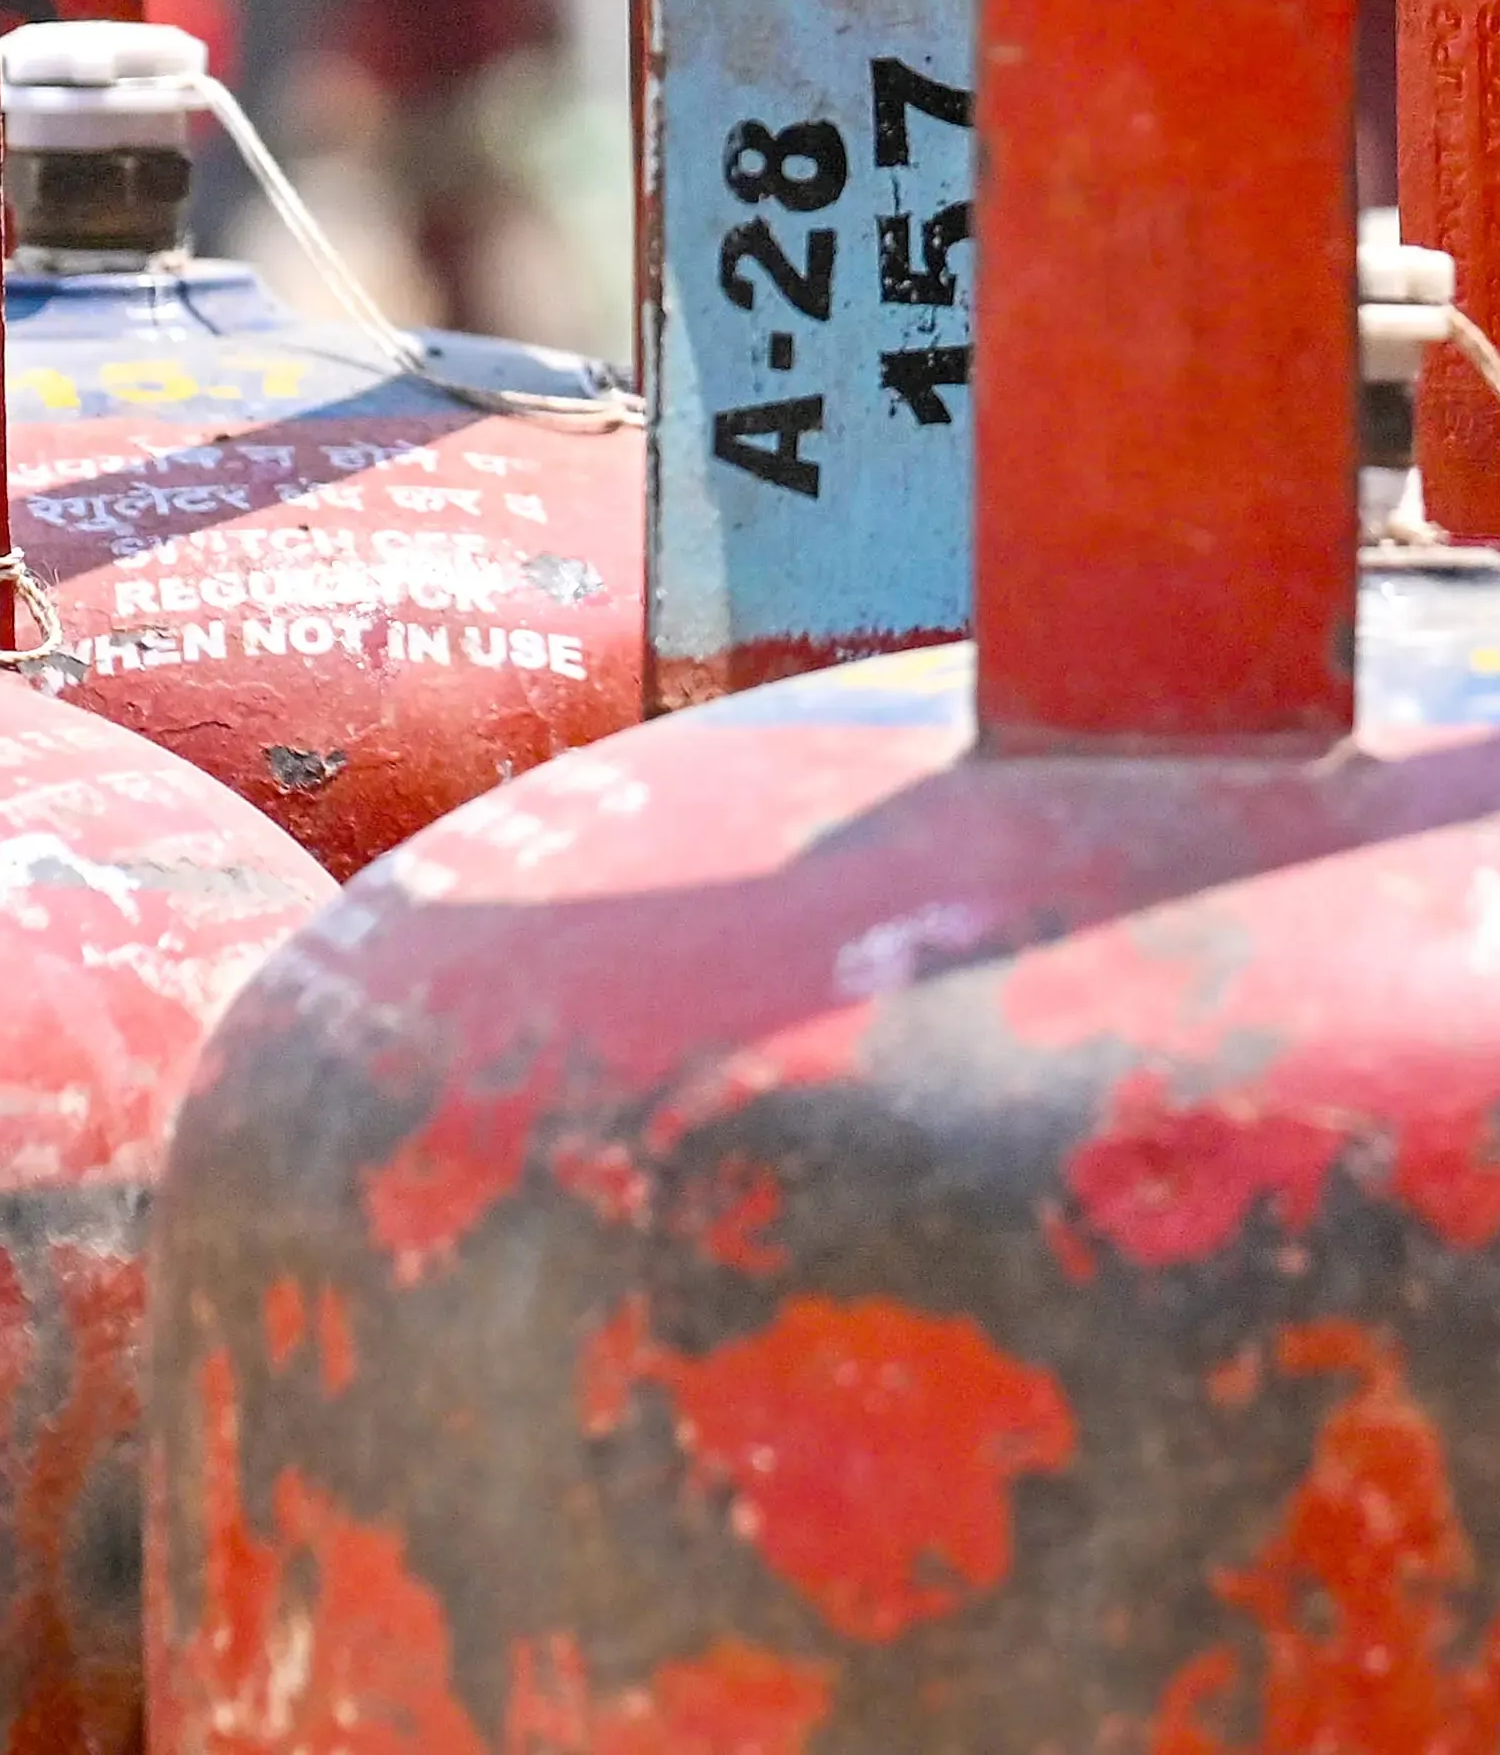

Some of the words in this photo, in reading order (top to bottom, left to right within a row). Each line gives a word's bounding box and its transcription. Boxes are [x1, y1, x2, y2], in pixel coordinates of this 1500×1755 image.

[710, 115, 851, 501] A-28
[386, 485, 482, 516] कर
[244, 616, 373, 657] NOT
[388, 621, 454, 665] IN
[464, 626, 588, 679] USE
